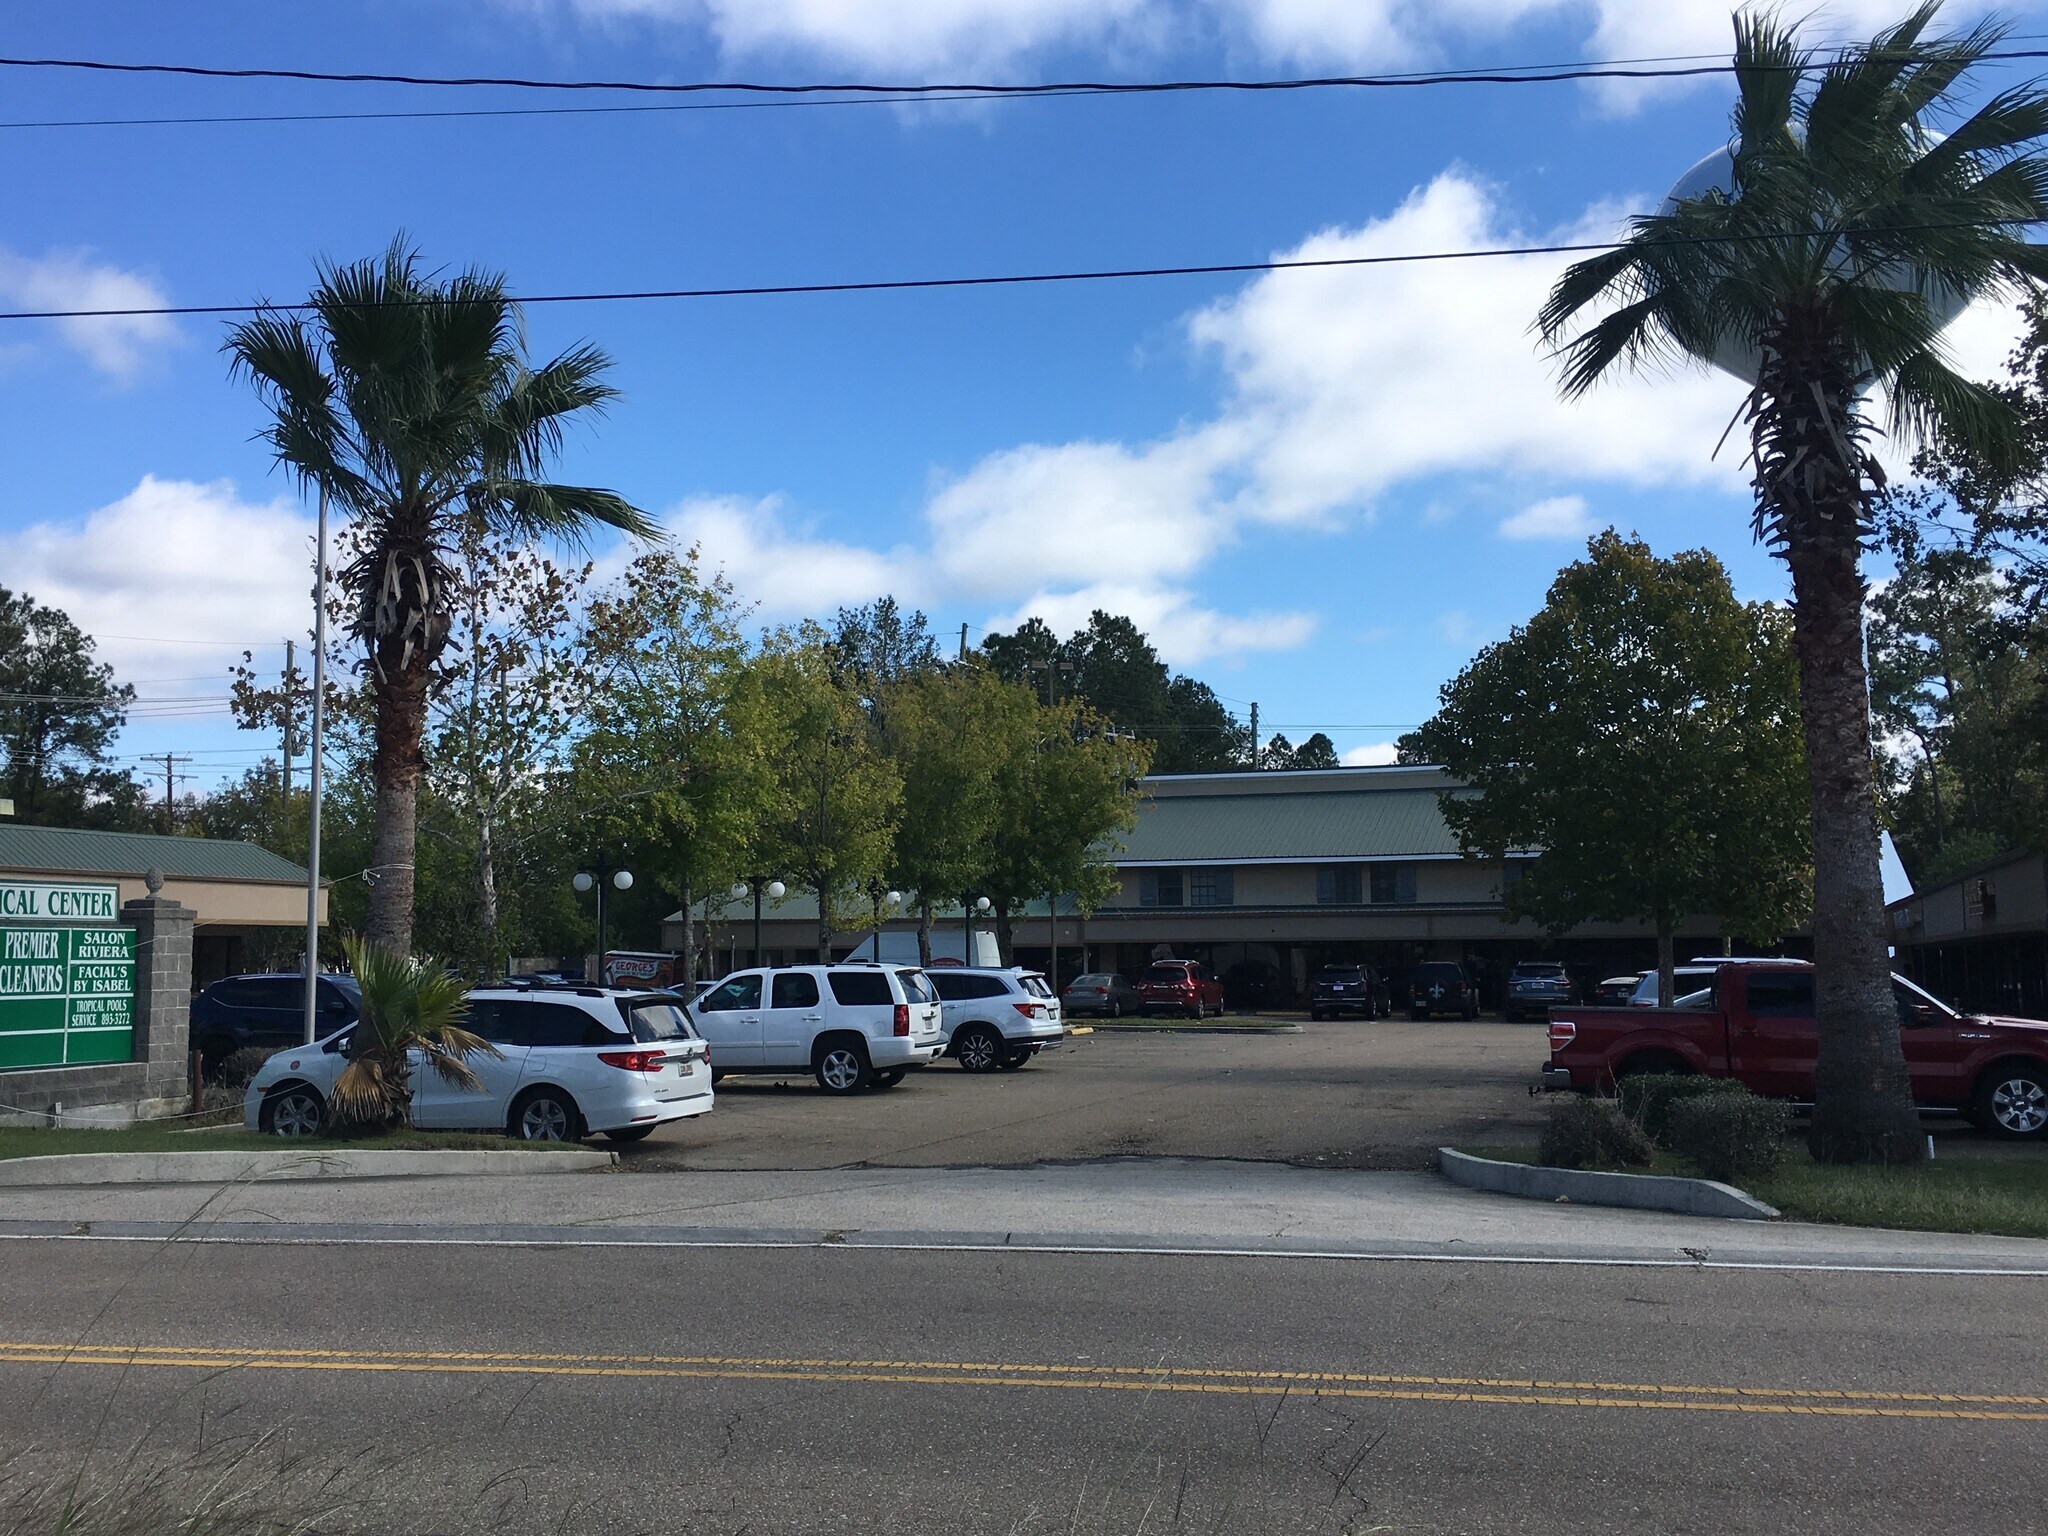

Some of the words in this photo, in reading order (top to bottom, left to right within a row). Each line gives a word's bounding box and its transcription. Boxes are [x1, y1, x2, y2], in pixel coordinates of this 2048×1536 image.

[48, 890, 112, 916] CENTER
[5, 931, 59, 959] PREMIER
[84, 932, 126, 945] SALON
[78, 945, 129, 958] RIVIERA
[0, 964, 63, 993] CLEANERS
[78, 966, 128, 978] FACIAL'S
[73, 980, 88, 992] BY
[92, 979, 132, 992] ISABEL
[76, 1000, 105, 1012] TROPICAL
[107, 999, 127, 1011] POOLS
[71, 1014, 97, 1027] SERVICE
[101, 1012, 130, 1025] 893-3272
